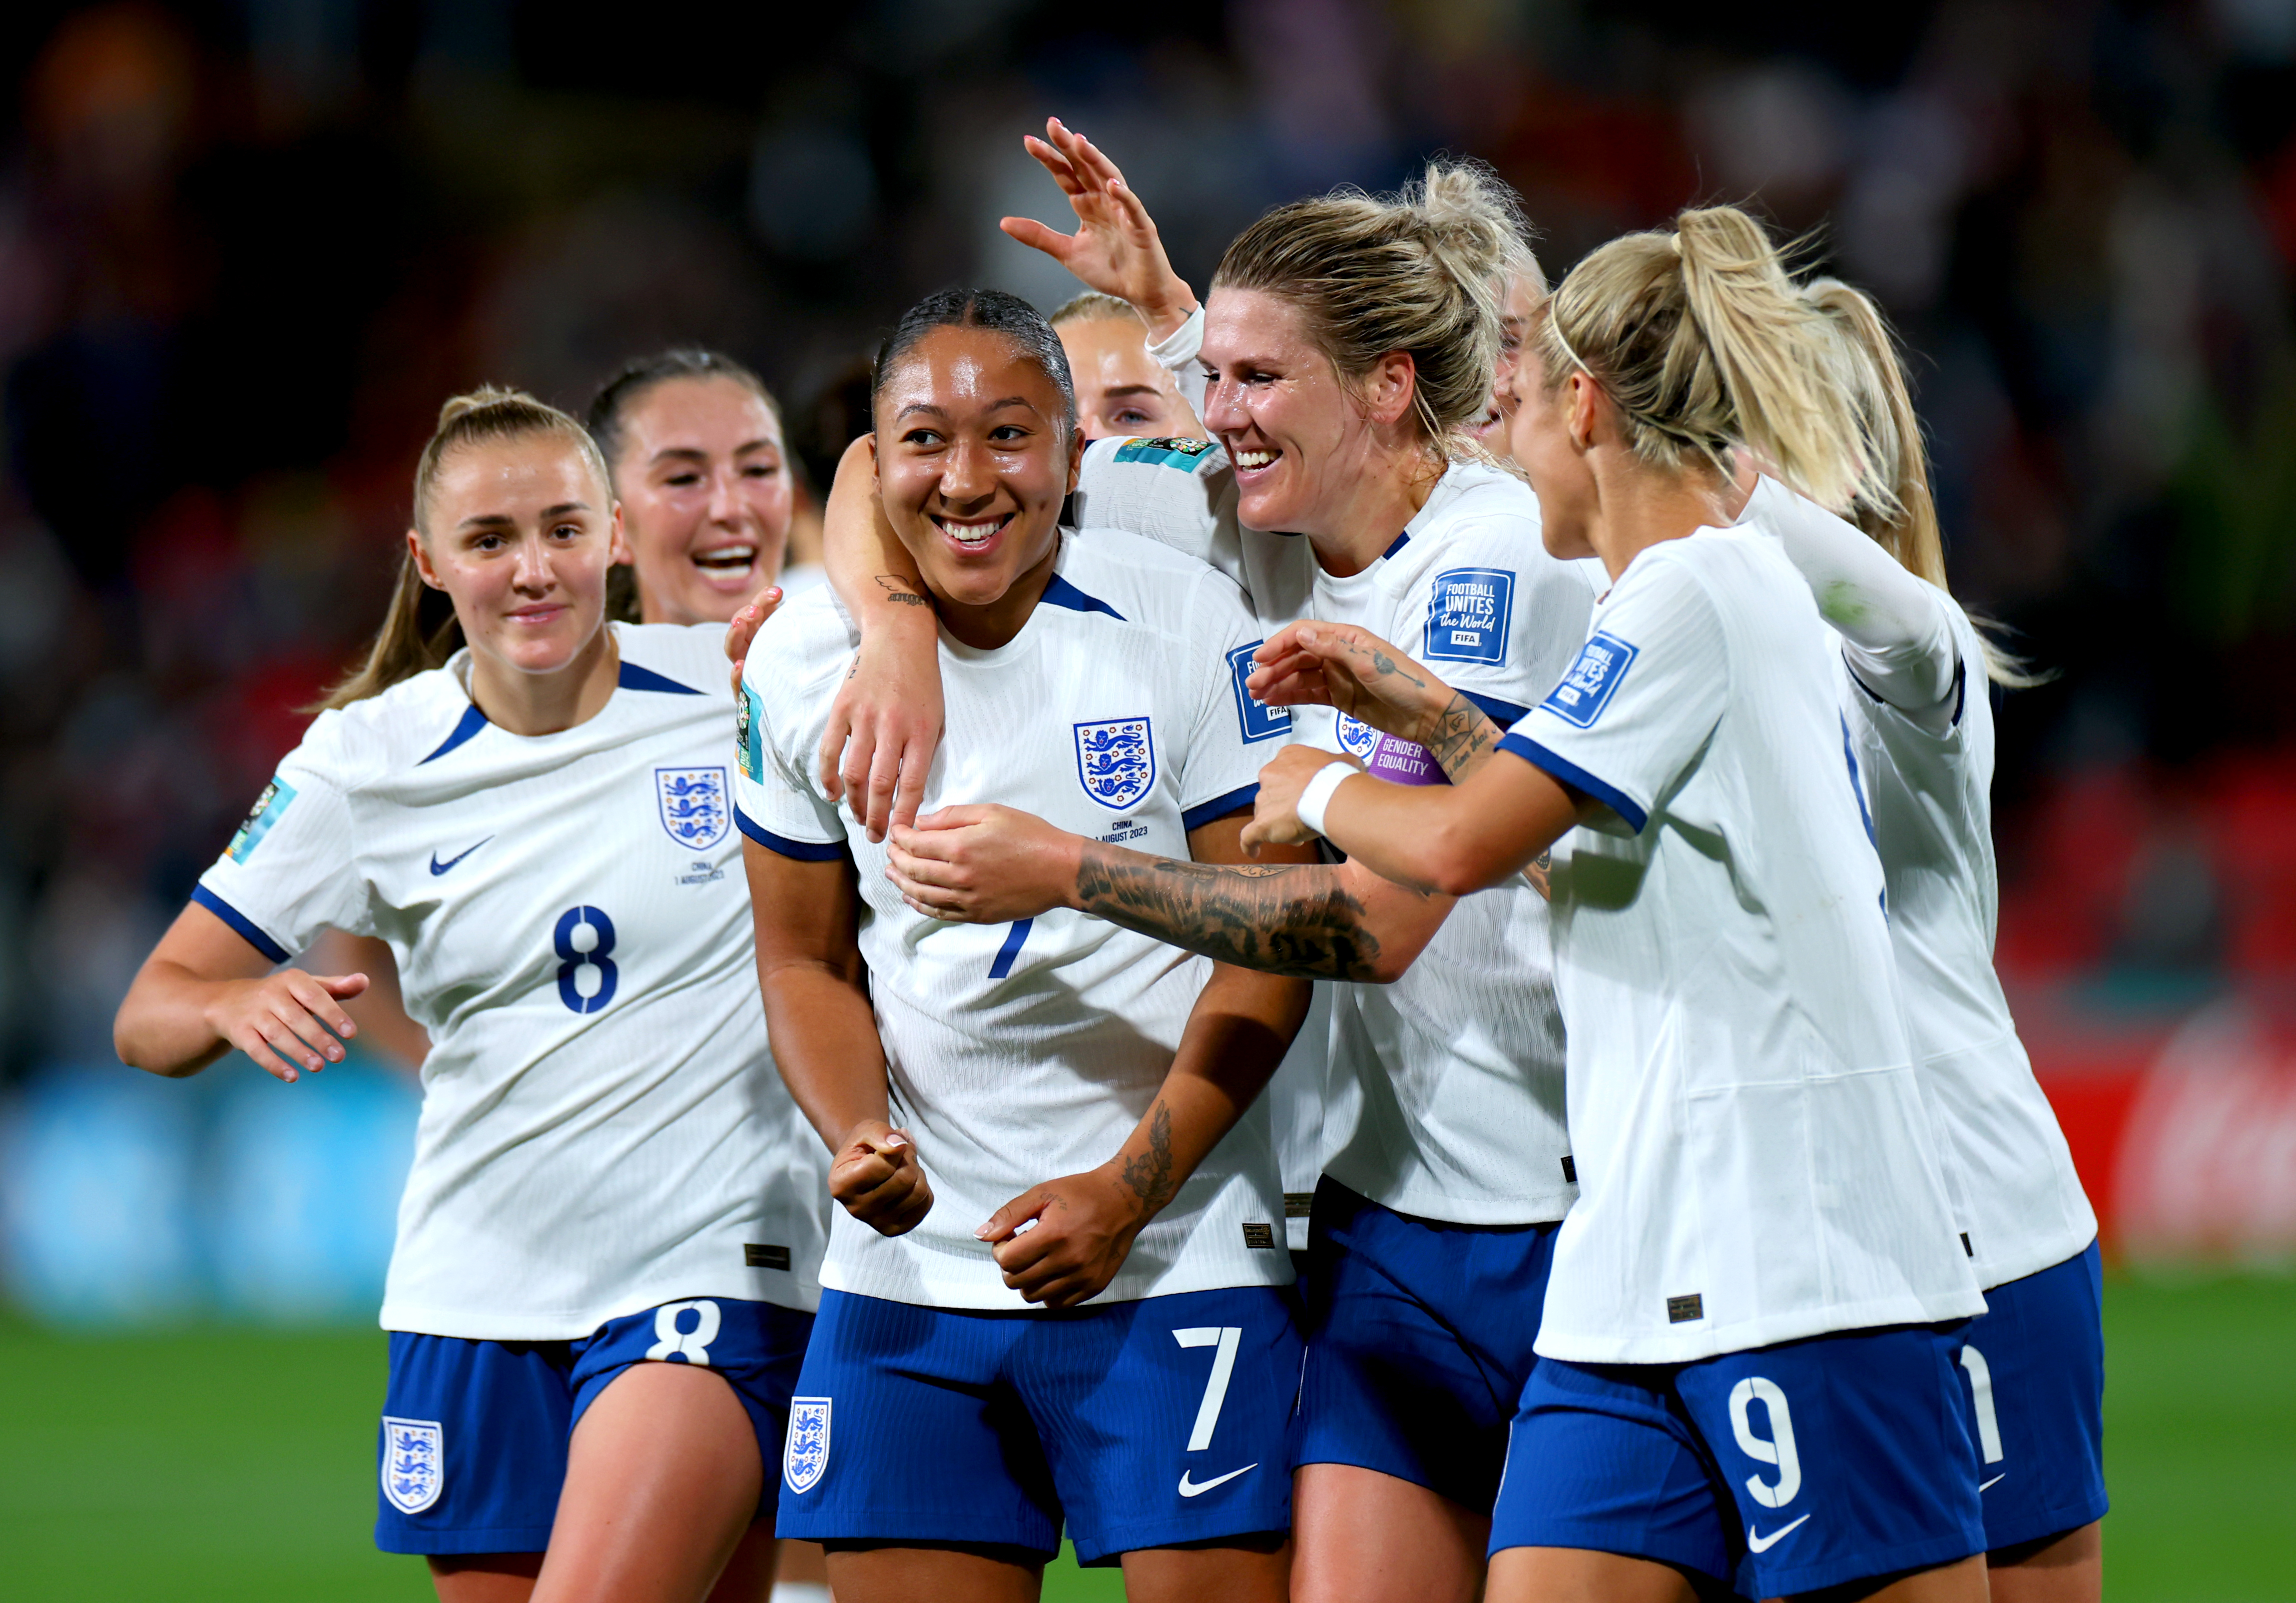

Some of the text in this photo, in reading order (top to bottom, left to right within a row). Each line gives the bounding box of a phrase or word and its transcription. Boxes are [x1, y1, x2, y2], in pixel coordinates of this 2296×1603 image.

[1446, 583, 1495, 597] FOOTBALL
[1445, 596, 1495, 615] UNITES
[1439, 613, 1496, 632] the World
[1455, 634, 1475, 643] FIFA
[1270, 706, 1287, 717] FIFA
[1382, 738, 1423, 759] GENDER
[1377, 754, 1429, 776] EQUALITY
[1102, 826, 1148, 842] AUGUST 2023
[1112, 820, 1132, 830] CHINA
[555, 905, 618, 1014] 8
[645, 1300, 721, 1365] 8
[1171, 1327, 1242, 1451] 7
[1960, 1344, 2003, 1465] 1
[1728, 1376, 1801, 1508] 9
